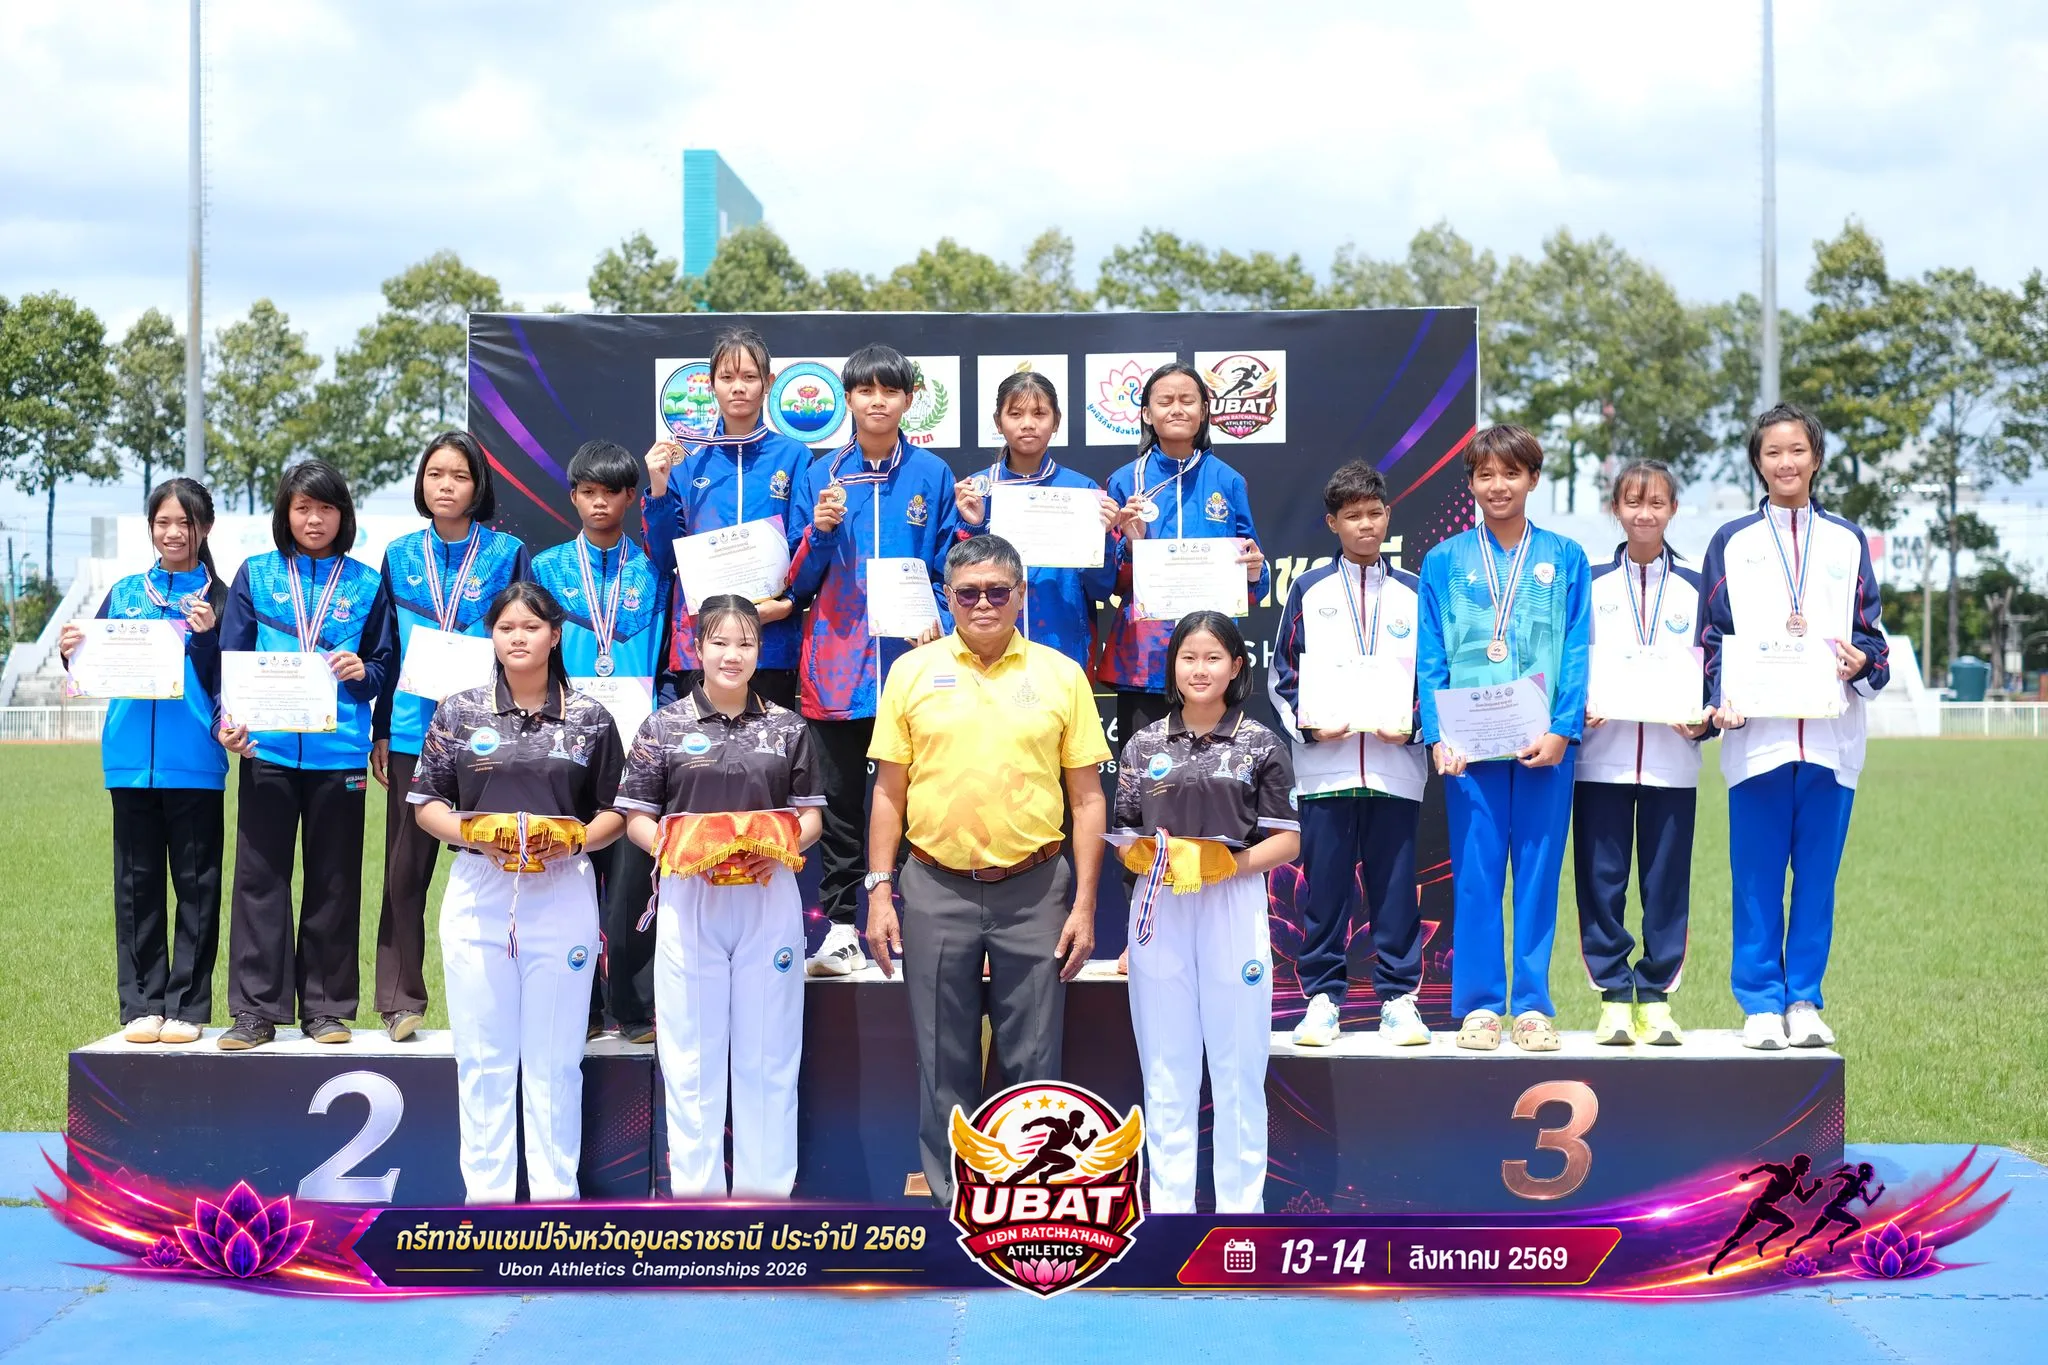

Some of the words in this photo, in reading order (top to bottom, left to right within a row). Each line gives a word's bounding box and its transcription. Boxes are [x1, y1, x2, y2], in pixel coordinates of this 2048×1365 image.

[1210, 398, 1271, 415] UBAT
[295, 1070, 405, 1204] 2
[1501, 1080, 1599, 1200] 3
